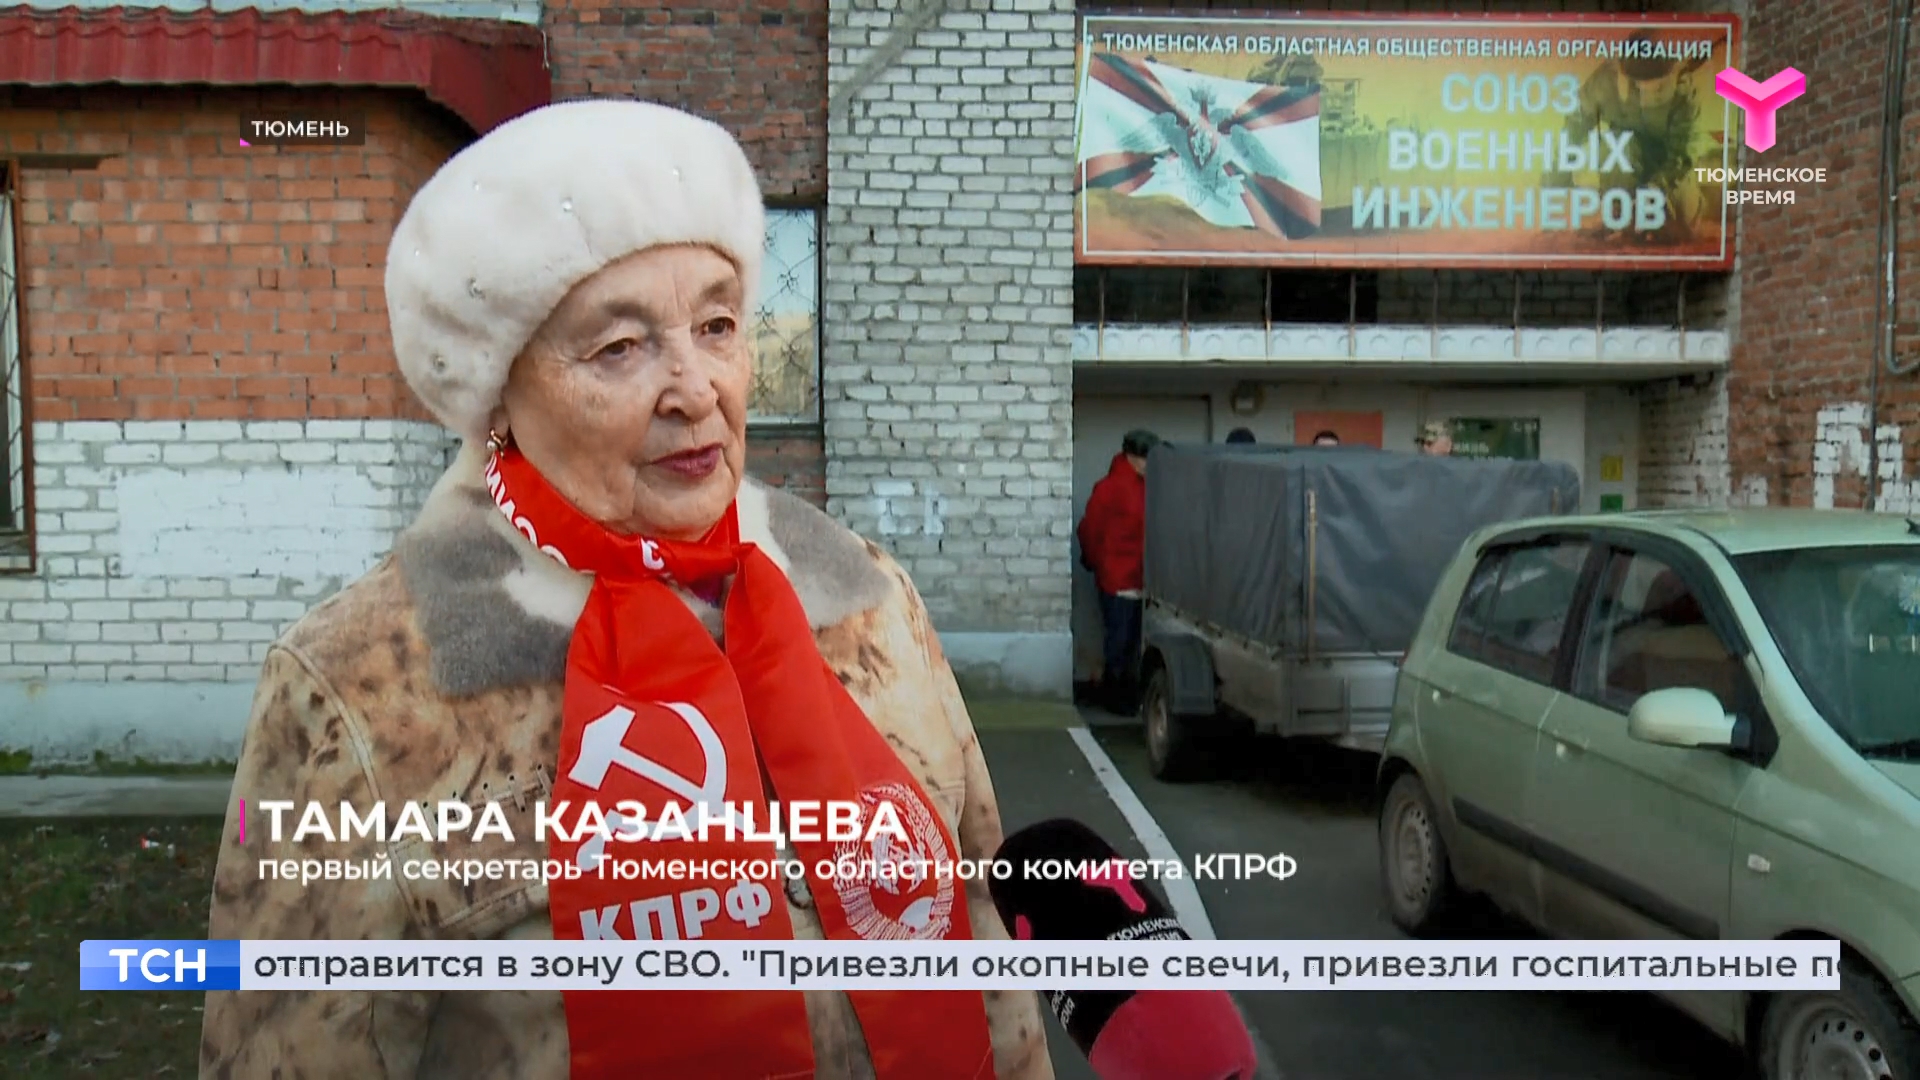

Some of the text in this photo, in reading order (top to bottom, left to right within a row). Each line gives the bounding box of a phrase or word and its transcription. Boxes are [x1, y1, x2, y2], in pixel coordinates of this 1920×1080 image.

[1102, 32, 1713, 61] ТЮМЕНСКАЯ ОБЛАСТНАЯ ОБЩЕСТВЕННАЯ ОРГАНИЗАЦИЯ
[1440, 71, 1581, 115] СОЮЗ
[1387, 128, 1635, 174] ВОЕННЫХ
[1350, 186, 1668, 232] ИНЖЕНЕРОВ
[578, 878, 772, 940] КПРФ
